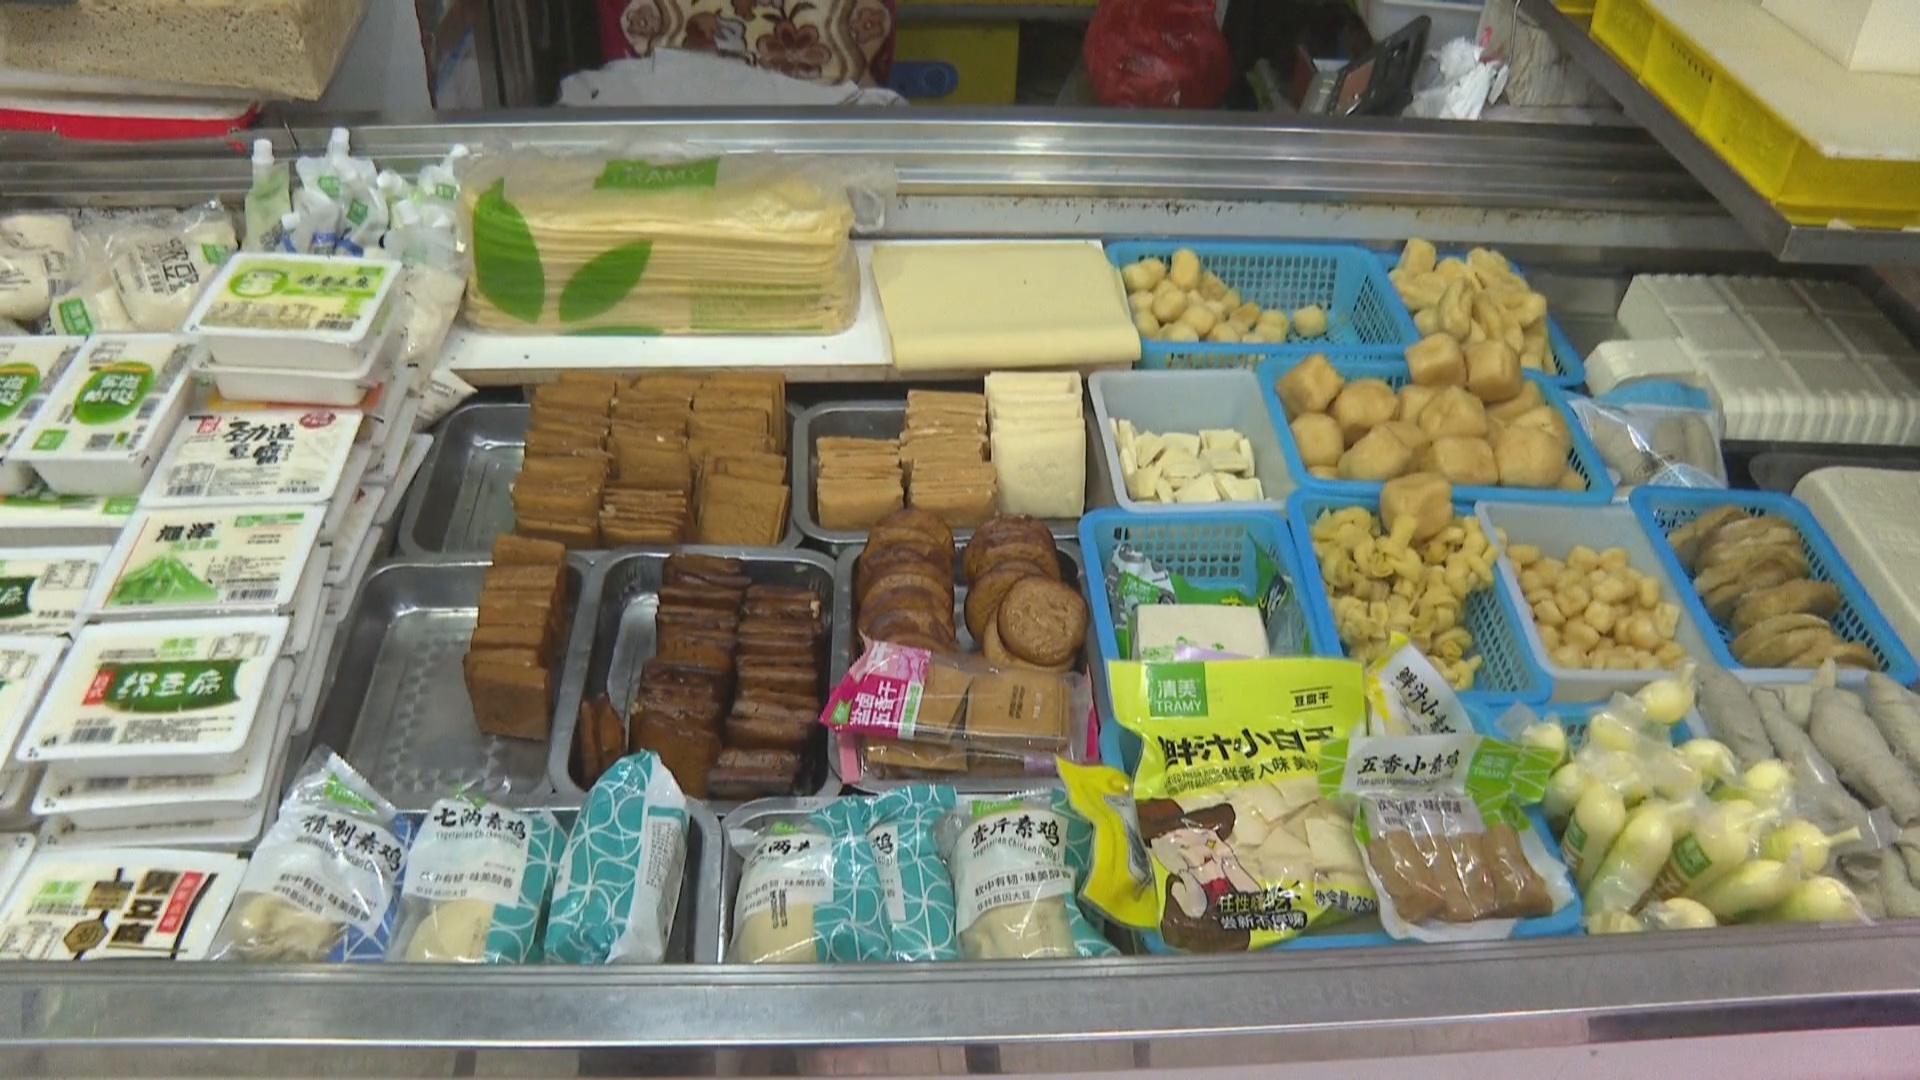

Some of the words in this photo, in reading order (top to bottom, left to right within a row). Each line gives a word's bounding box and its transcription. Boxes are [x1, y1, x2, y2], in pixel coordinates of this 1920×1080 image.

[1158, 679, 1197, 699] 清美
[1156, 699, 1202, 713] TRAMY
[1294, 691, 1330, 708] 豆腐干
[1395, 665, 1457, 734] 鲜汁小素
[971, 814, 1060, 850] 壹斤素鸡
